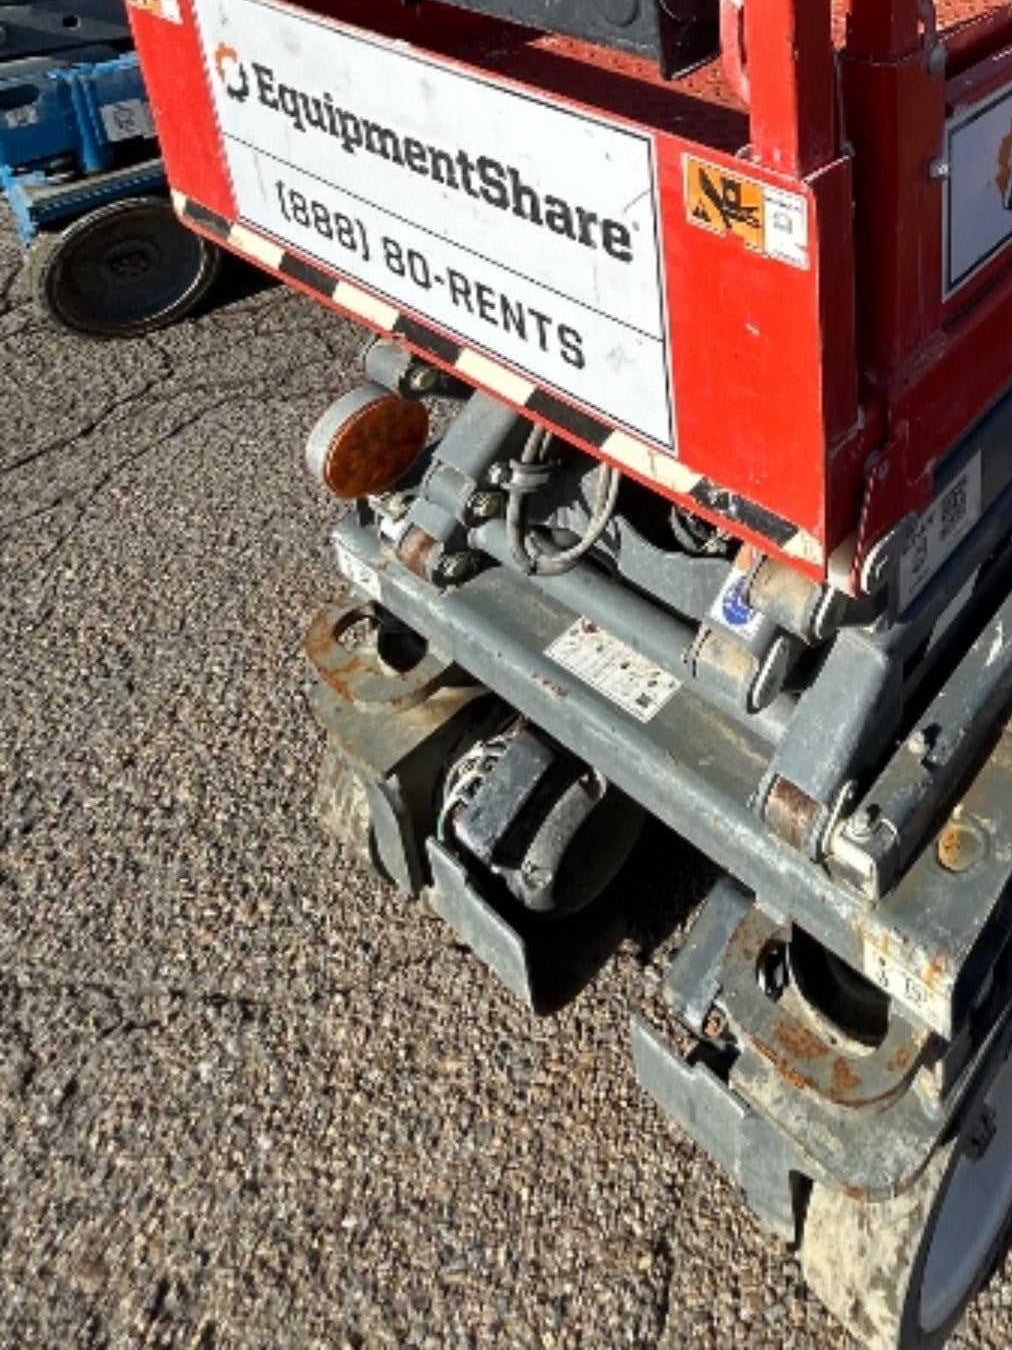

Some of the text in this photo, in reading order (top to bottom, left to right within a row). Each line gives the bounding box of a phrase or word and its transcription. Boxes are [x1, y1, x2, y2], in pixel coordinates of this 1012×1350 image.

[251, 62, 634, 263] EquipmentShare
[274, 179, 586, 370] (888) 80-RENTS
